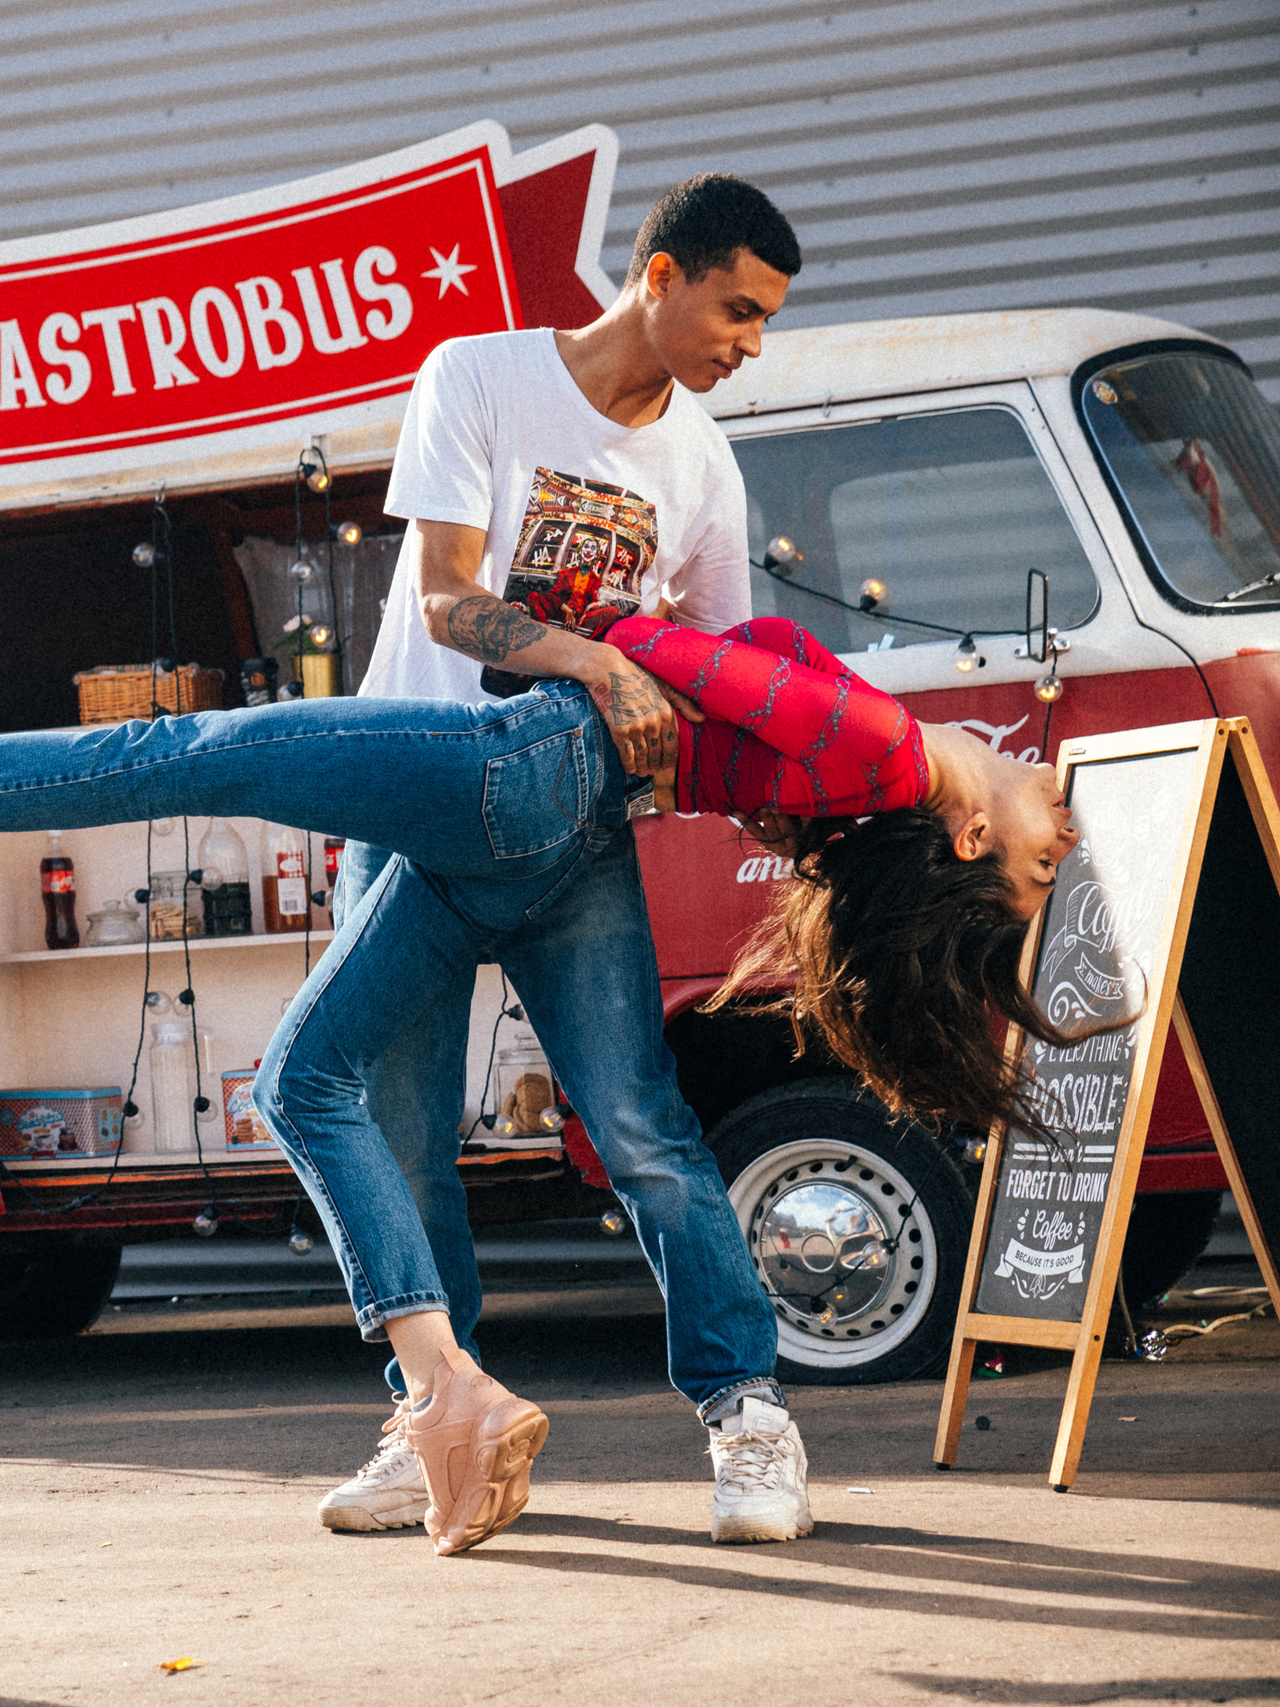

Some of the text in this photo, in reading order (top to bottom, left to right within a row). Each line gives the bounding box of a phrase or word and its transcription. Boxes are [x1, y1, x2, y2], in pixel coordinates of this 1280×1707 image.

[1085, 969, 1113, 996] makes
[1028, 1073, 1124, 1134] POSSIBLE
[1051, 1141, 1083, 1162] Don't
[1006, 1169, 1108, 1202] FORGET TO DRINK
[1033, 1209, 1073, 1250] Coffee
[1015, 1249, 1074, 1268] BECAUSE IT'S GOOD
